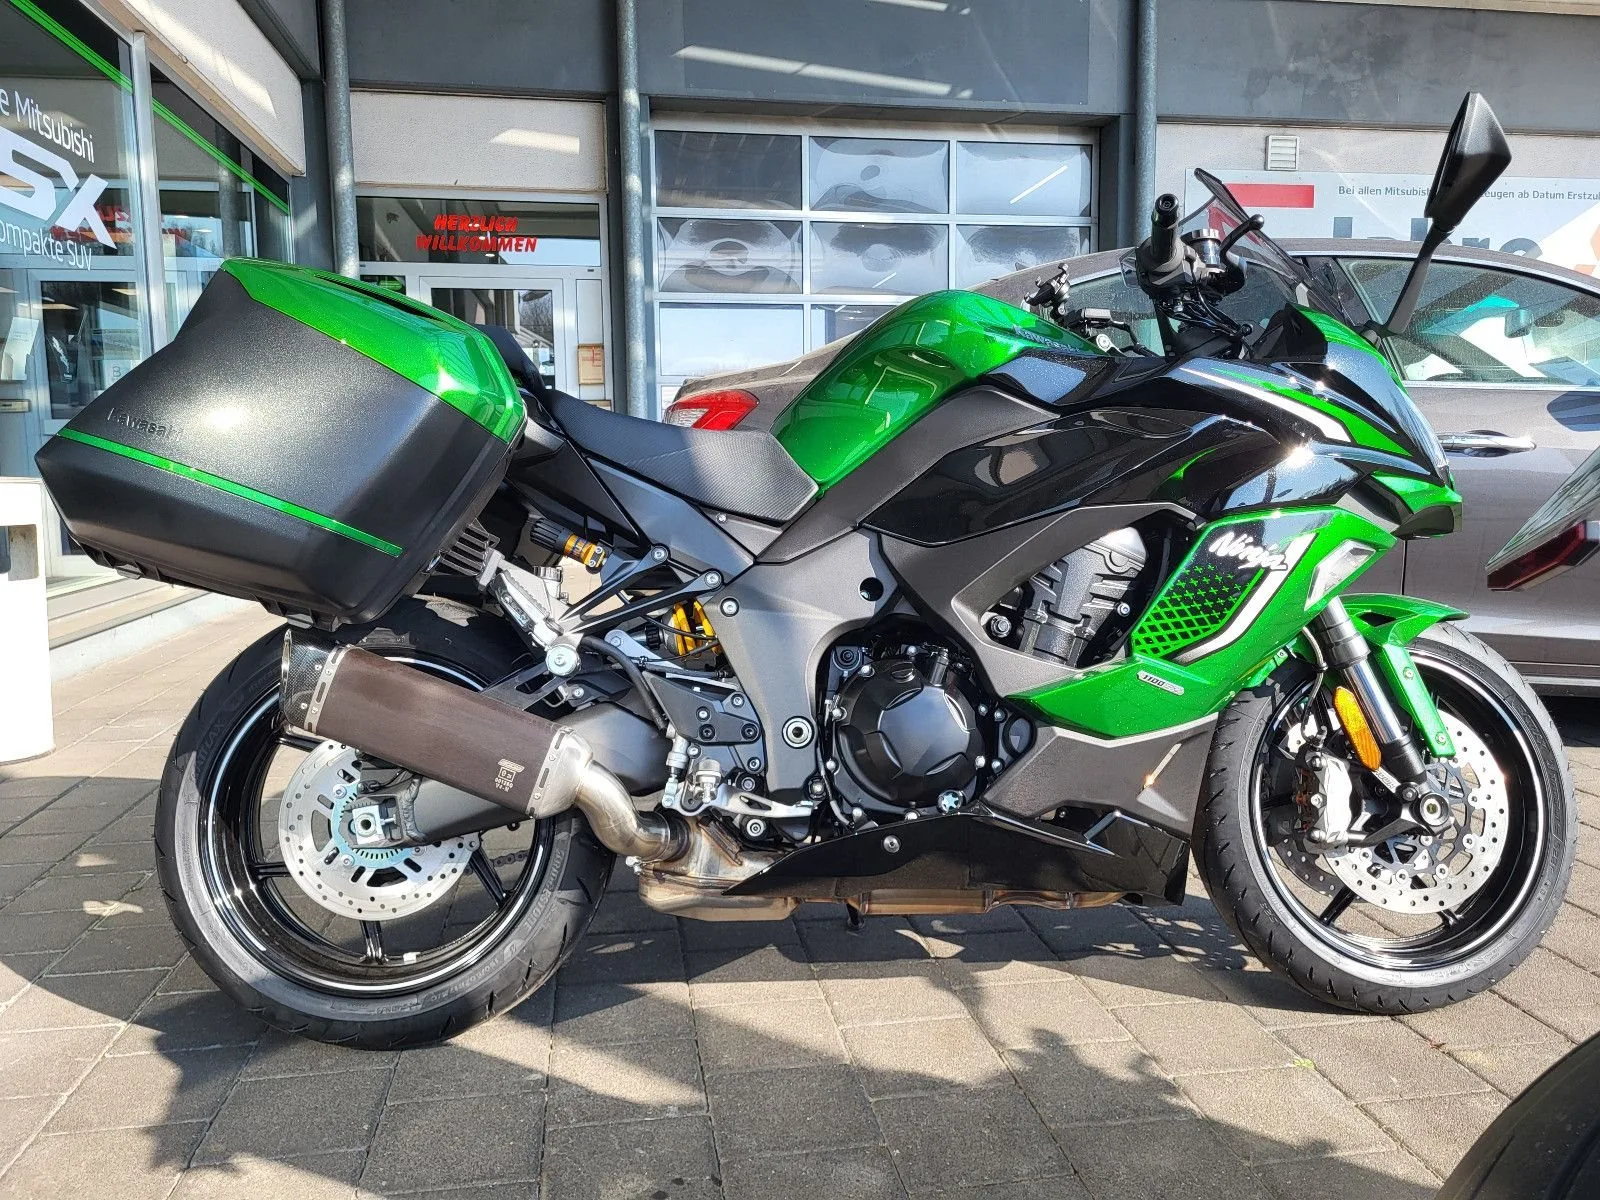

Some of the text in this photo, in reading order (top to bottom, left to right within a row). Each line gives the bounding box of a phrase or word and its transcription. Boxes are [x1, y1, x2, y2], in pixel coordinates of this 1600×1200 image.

[14, 90, 95, 163] Mitsubishi
[1338, 185, 1355, 195] Bei
[1358, 186, 1382, 196] allen
[1384, 186, 1430, 197] Mitsubis
[1480, 190, 1515, 200] eugen
[1517, 189, 1530, 199] ab
[1532, 191, 1565, 200] Datum
[434, 214, 518, 232] HERZLICH
[416, 234, 538, 253] WILLKOMMEN
[67, 241, 93, 271] SUV
[1208, 531, 1288, 571] Ninja
